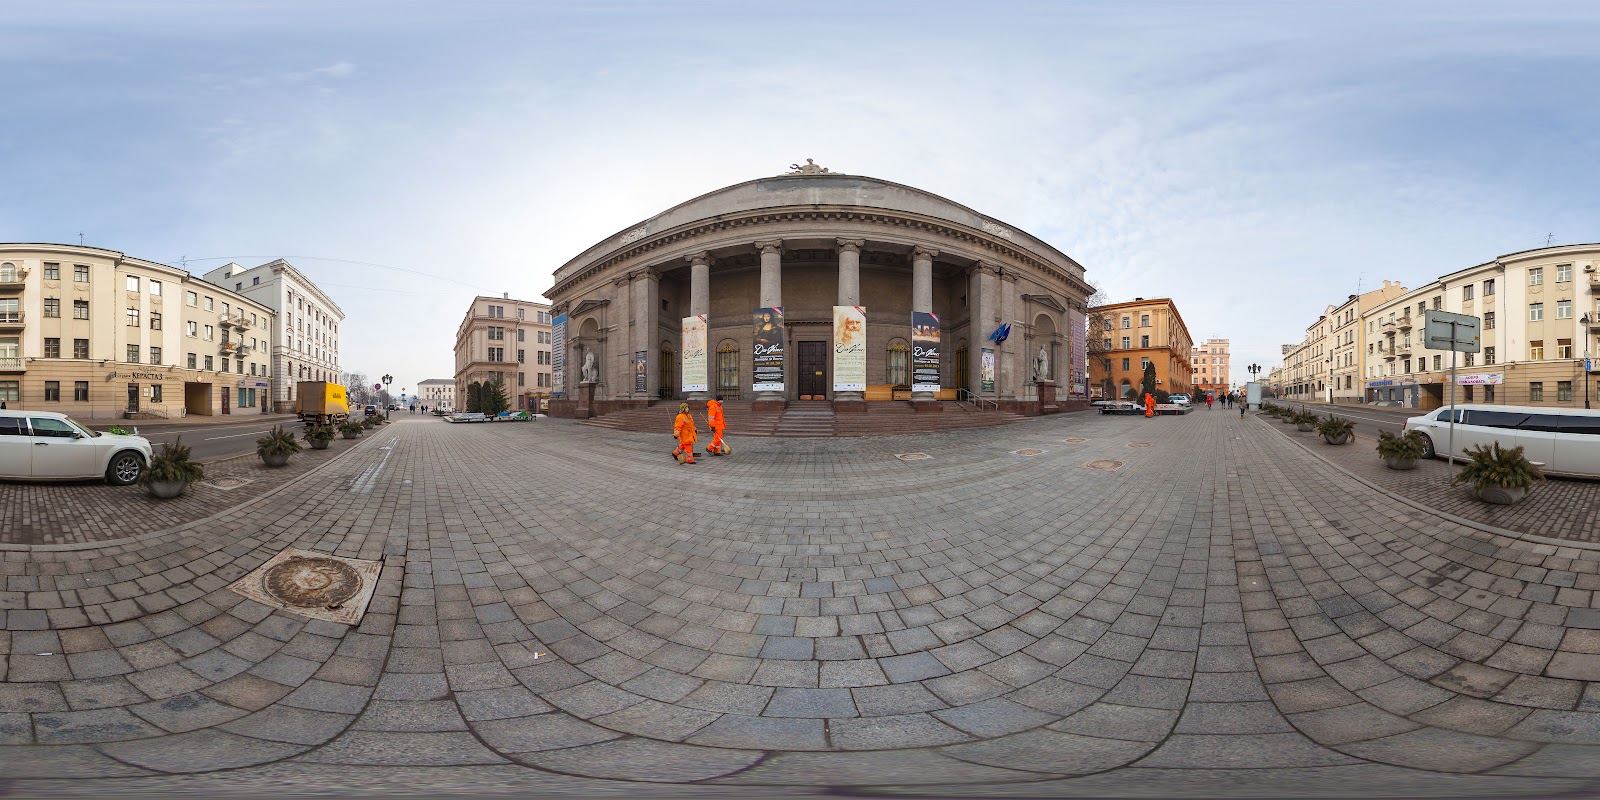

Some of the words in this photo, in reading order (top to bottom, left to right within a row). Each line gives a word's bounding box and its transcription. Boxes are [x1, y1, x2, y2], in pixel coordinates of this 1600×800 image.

[754, 344, 767, 355] Da
[767, 343, 784, 355] Vinci
[835, 343, 849, 354] Da
[849, 344, 866, 354] Vinci
[913, 346, 925, 356] Da
[925, 347, 940, 357] Vinci
[132, 371, 163, 380] КЕРАСТАЗ
